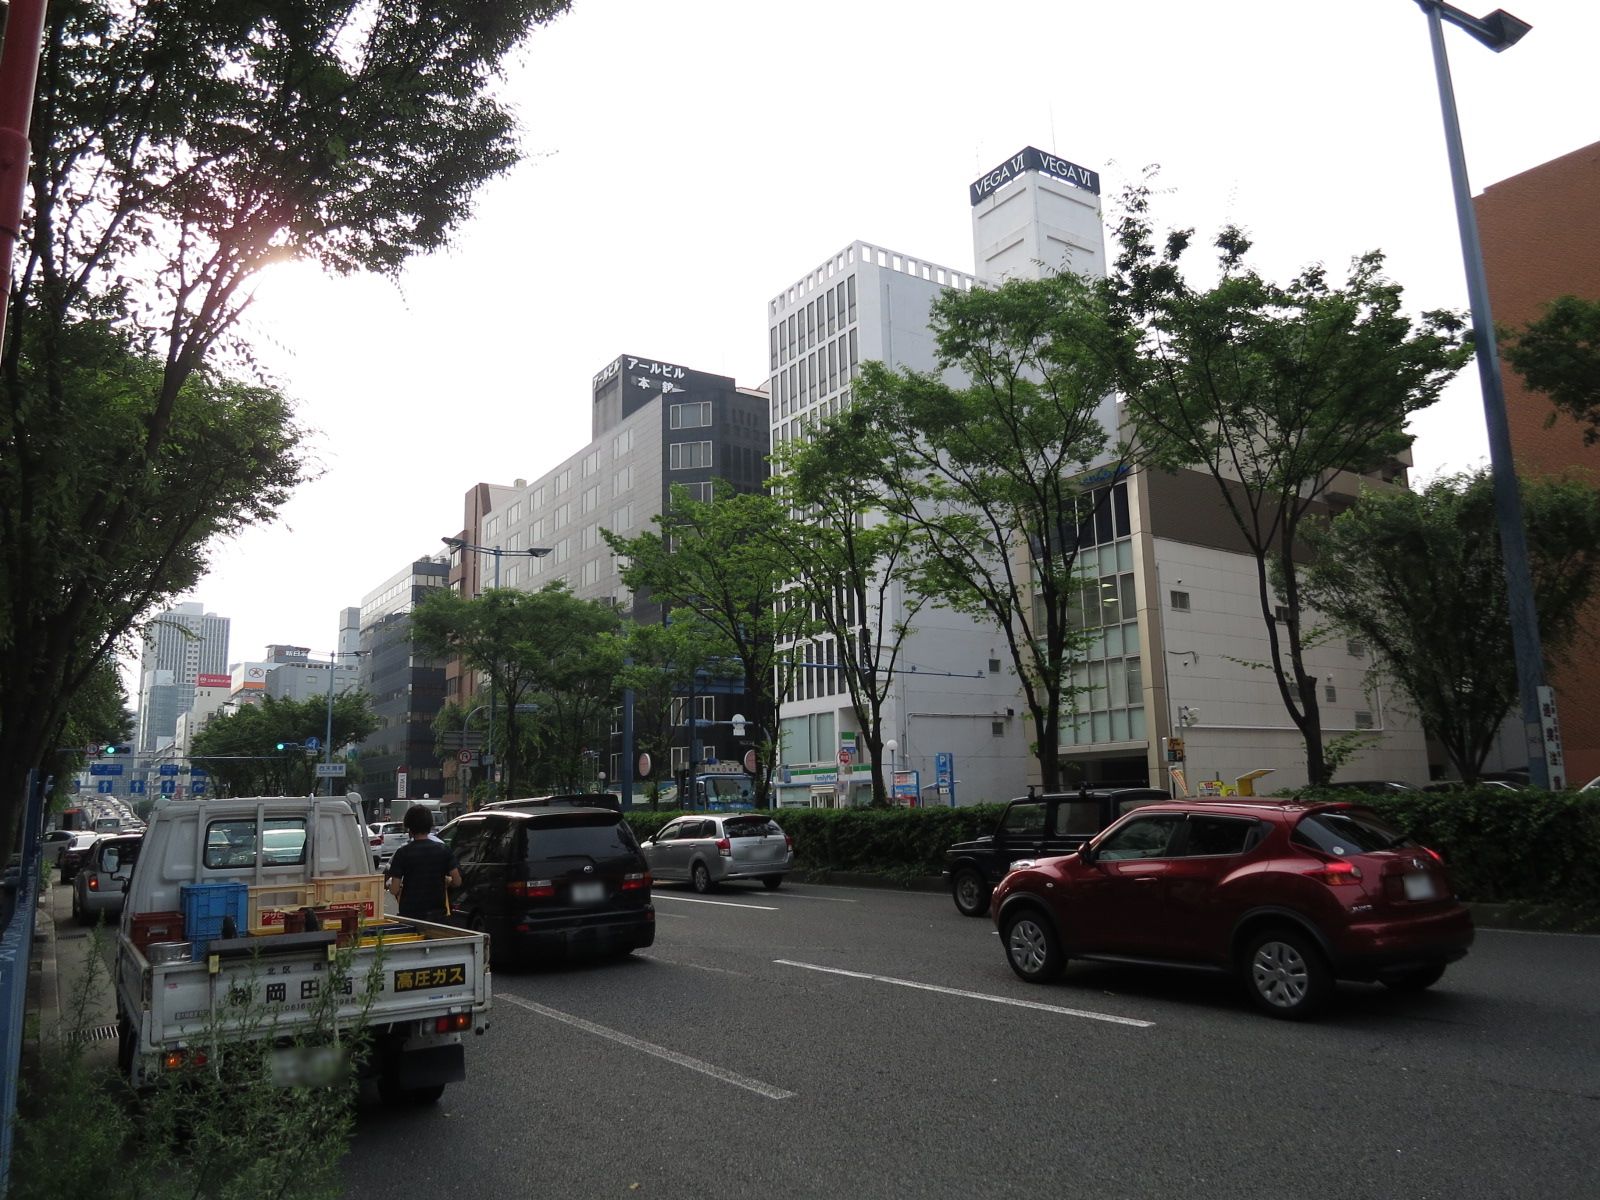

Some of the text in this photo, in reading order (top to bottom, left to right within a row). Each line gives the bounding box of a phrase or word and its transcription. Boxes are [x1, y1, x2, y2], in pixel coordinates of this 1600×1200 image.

[1039, 153, 1078, 181] VEGA
[974, 165, 1010, 196] VEGA
[627, 357, 685, 379] アールビル
[397, 967, 464, 989] 高圧ガス
